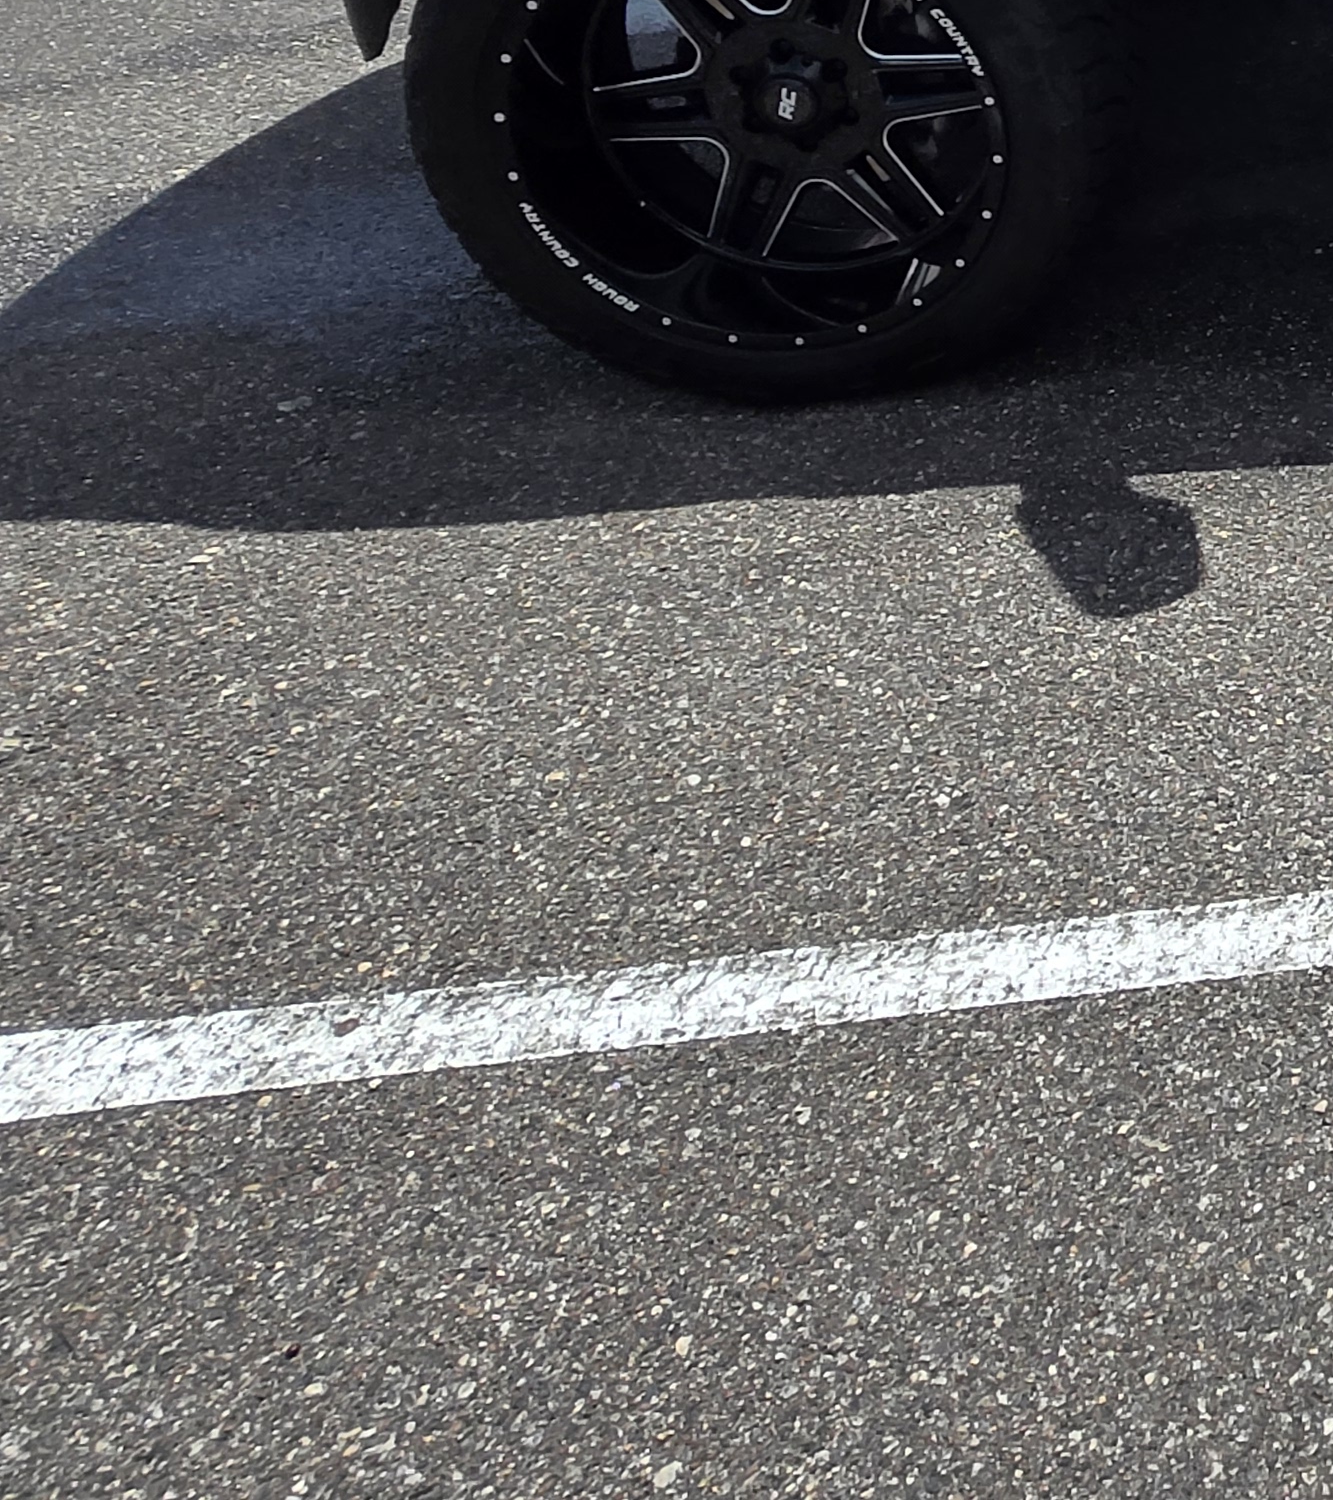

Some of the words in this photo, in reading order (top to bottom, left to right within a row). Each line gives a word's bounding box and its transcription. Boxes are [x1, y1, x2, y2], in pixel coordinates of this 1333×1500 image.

[929, 8, 985, 77] COUNTRY
[778, 87, 797, 120] RC
[519, 202, 580, 268] COUNTRY
[582, 273, 640, 312] ROUGH
